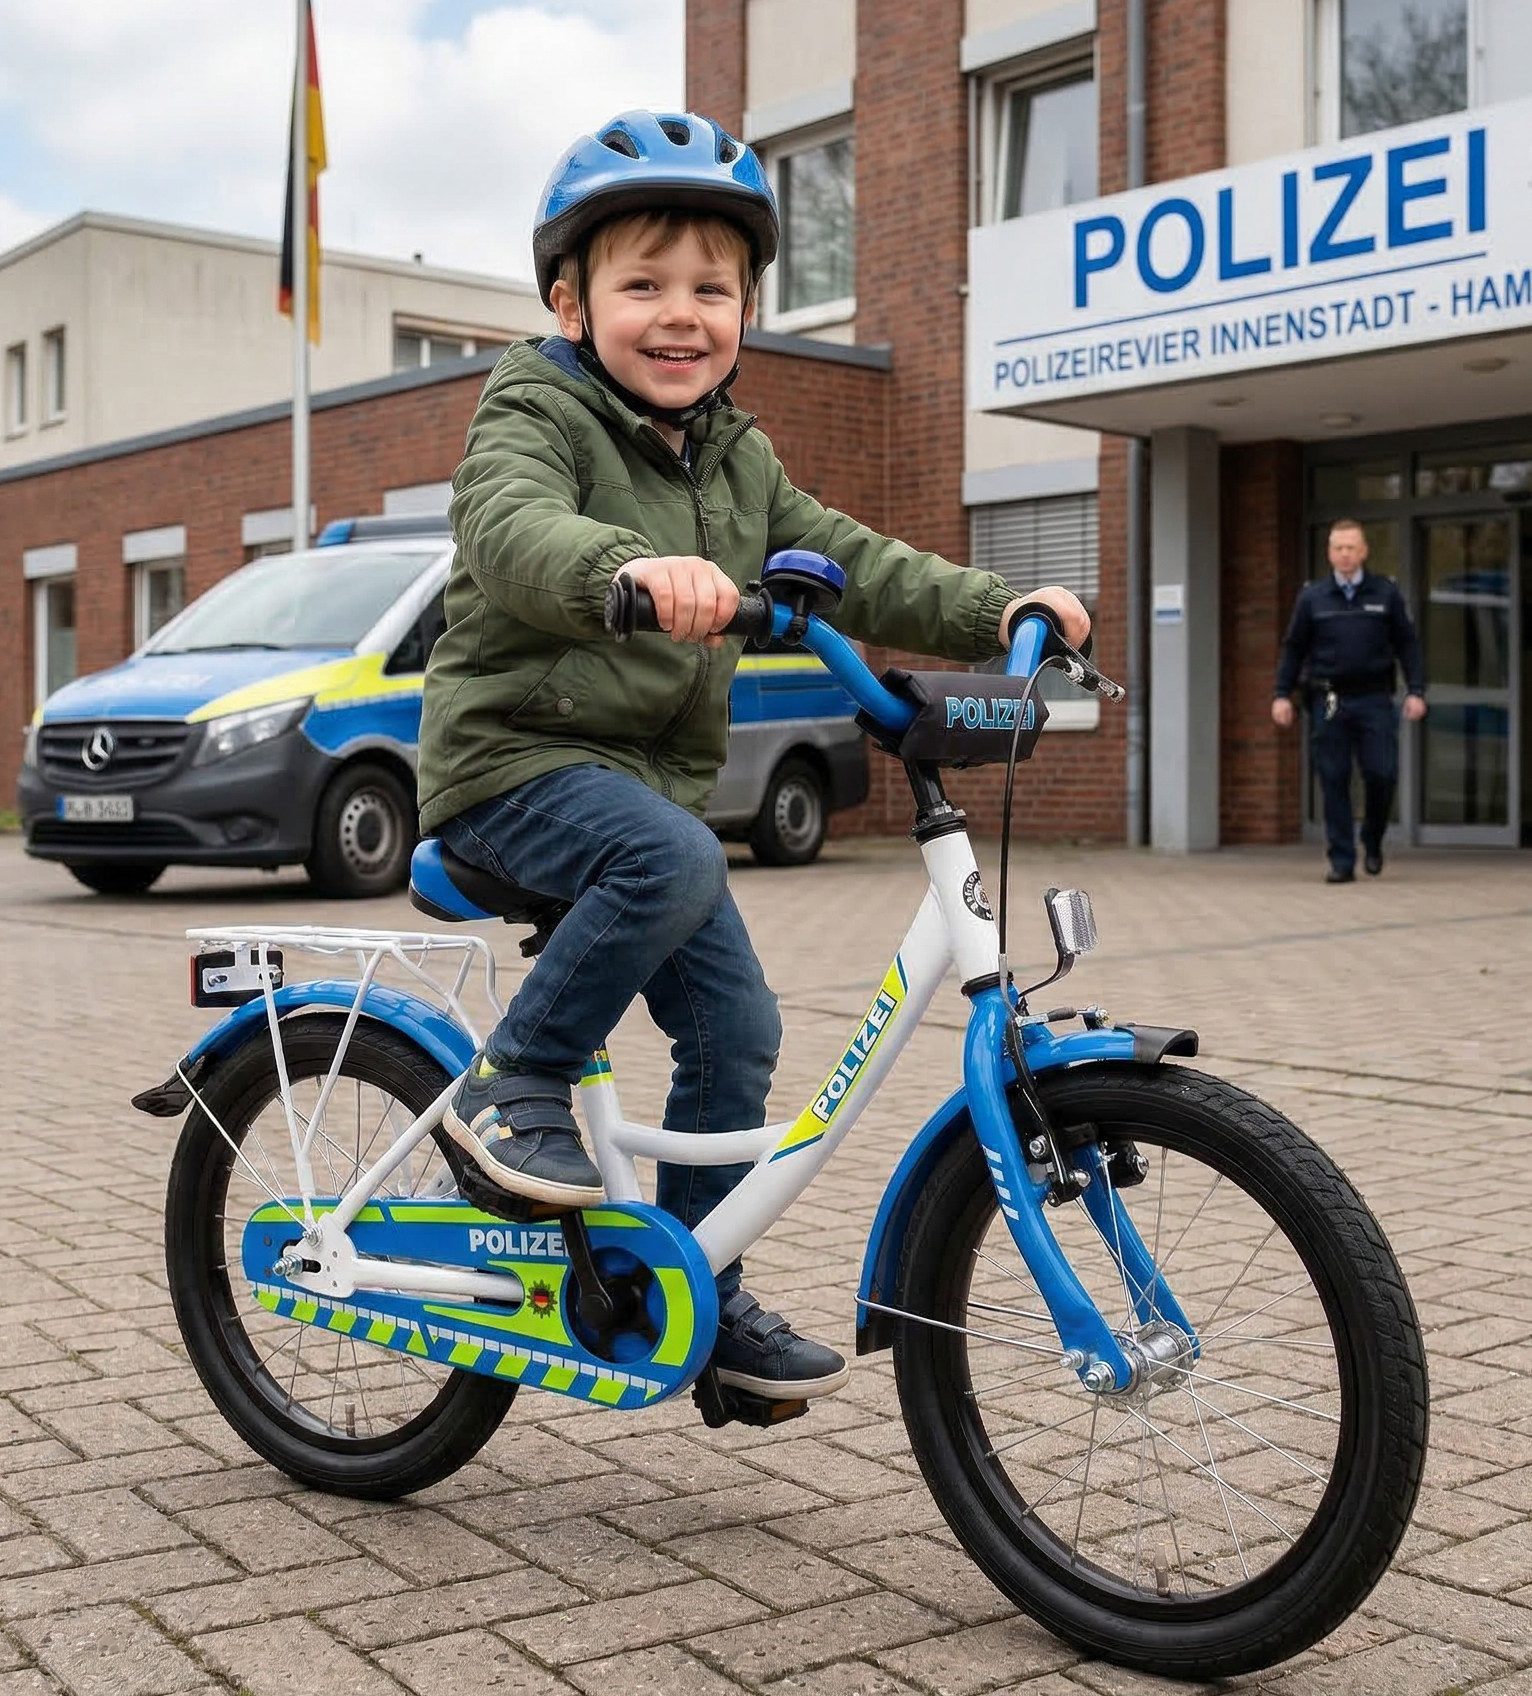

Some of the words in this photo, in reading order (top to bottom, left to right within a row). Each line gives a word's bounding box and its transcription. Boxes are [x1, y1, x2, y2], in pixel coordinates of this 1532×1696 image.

[1074, 128, 1486, 308] POLIZEI
[994, 328, 1201, 391] POLIZEIREVIER
[1210, 290, 1416, 357] INNENSTADT
[1452, 269, 1531, 316] HAM
[813, 991, 896, 1122] POLIZEI
